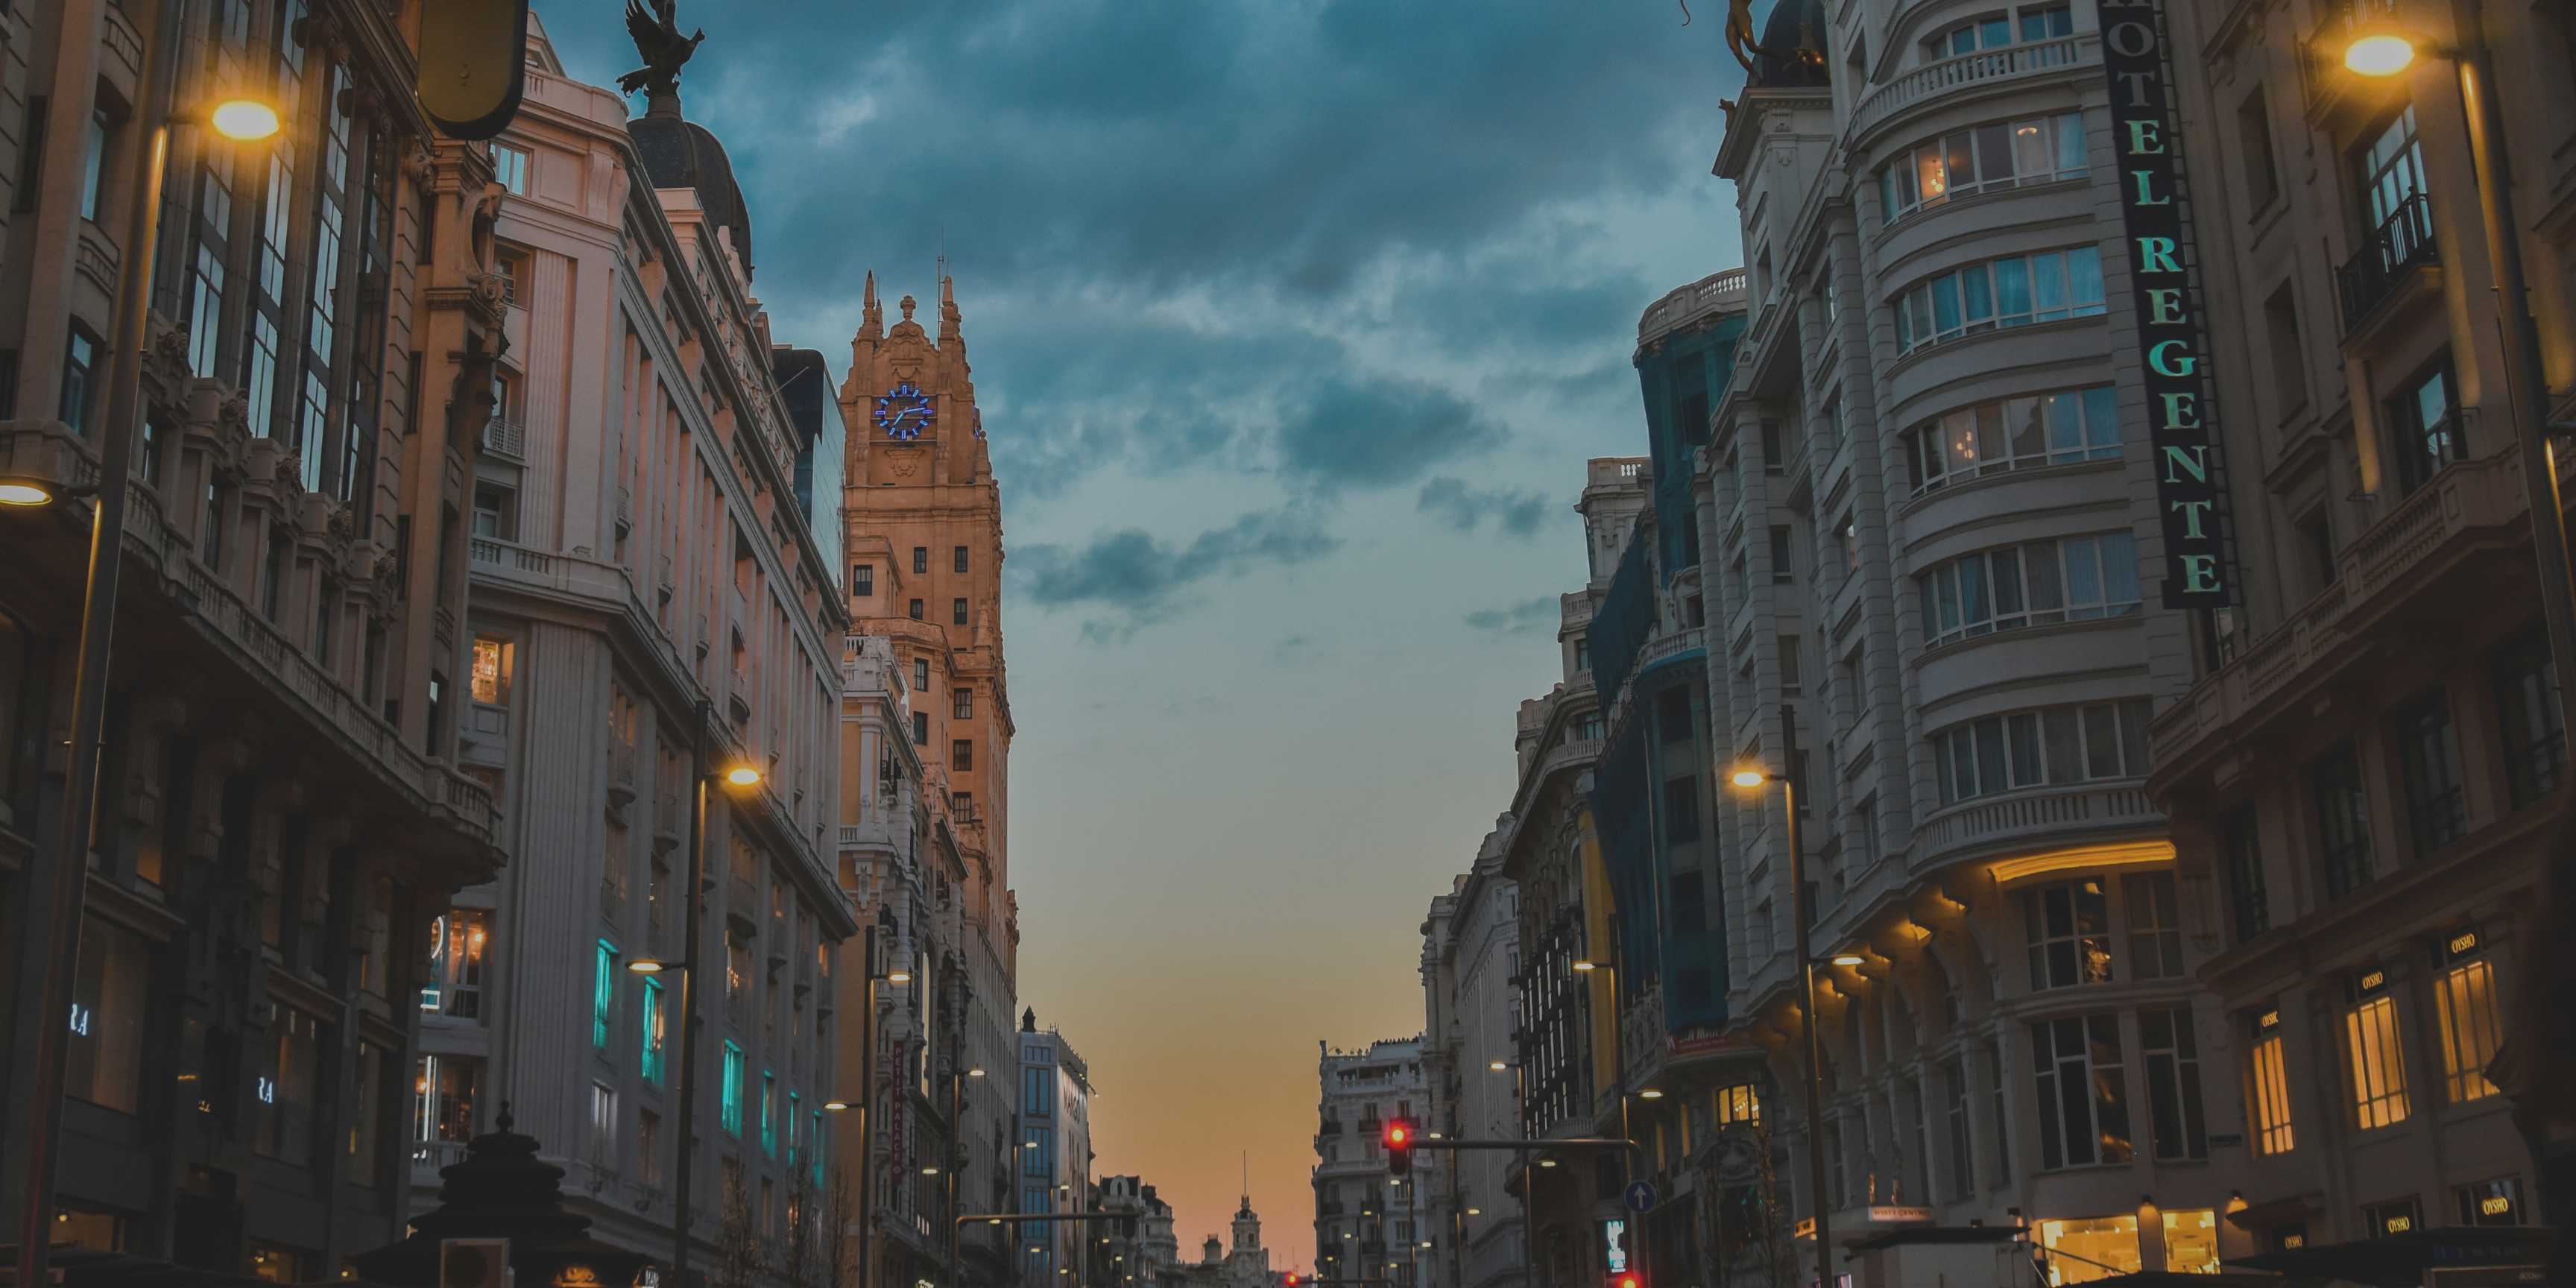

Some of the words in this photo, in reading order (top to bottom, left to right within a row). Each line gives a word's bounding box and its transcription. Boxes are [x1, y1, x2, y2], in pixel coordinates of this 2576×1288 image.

[2100, 0, 2171, 206] OTEL
[2135, 236, 2222, 593] REGENTE
[2451, 932, 2475, 954] OYSHO
[2362, 971, 2384, 990] OYSHO
[894, 1101, 902, 1161] PALACE
[2481, 1196, 2509, 1216] OYSHO
[2387, 1216, 2410, 1234] OYSHO
[2284, 1234, 2302, 1250] OYSHO
